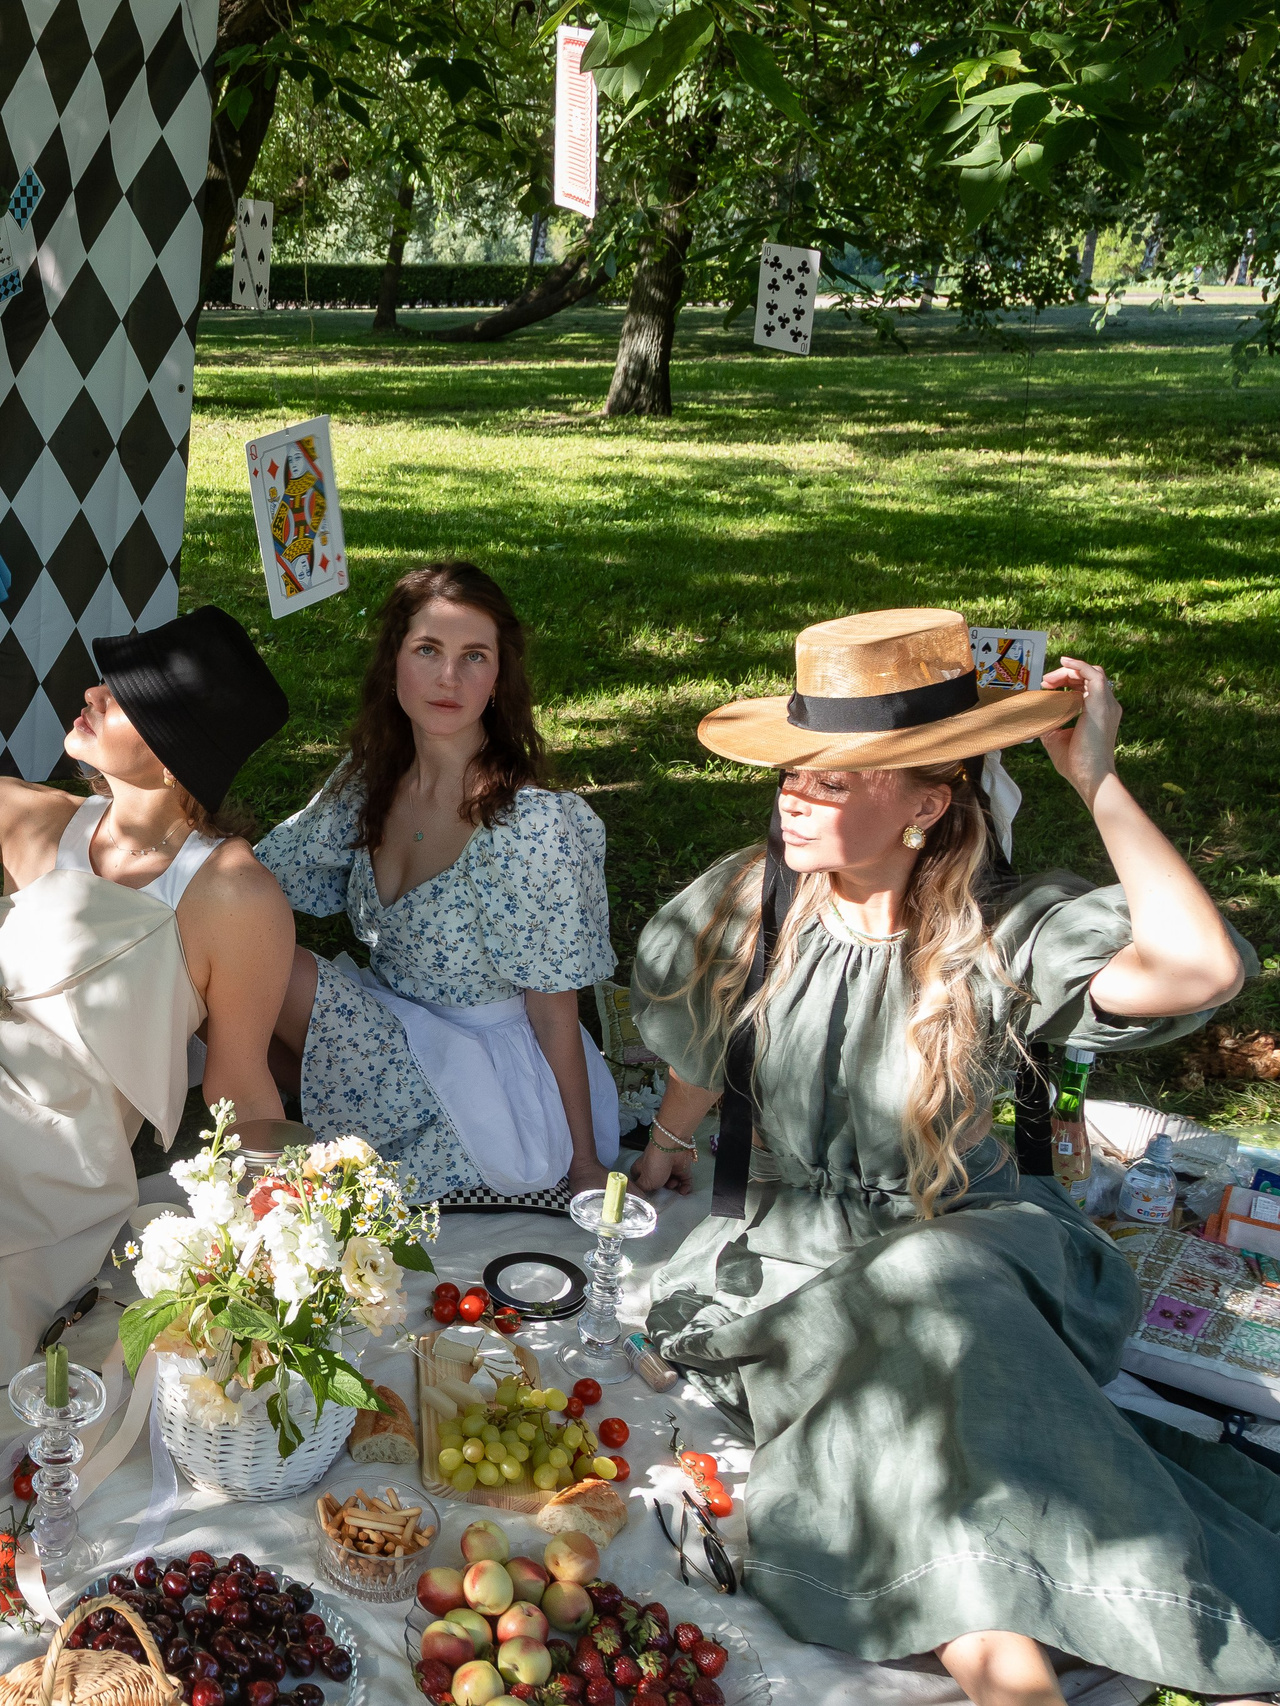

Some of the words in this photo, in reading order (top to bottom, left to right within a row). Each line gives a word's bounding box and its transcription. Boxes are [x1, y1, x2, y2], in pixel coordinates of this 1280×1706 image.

[239, 201, 244, 212] 6
[764, 246, 771, 257] 10
[800, 342, 808, 353] 10
[249, 444, 258, 461] Q
[971, 629, 978, 640] Q
